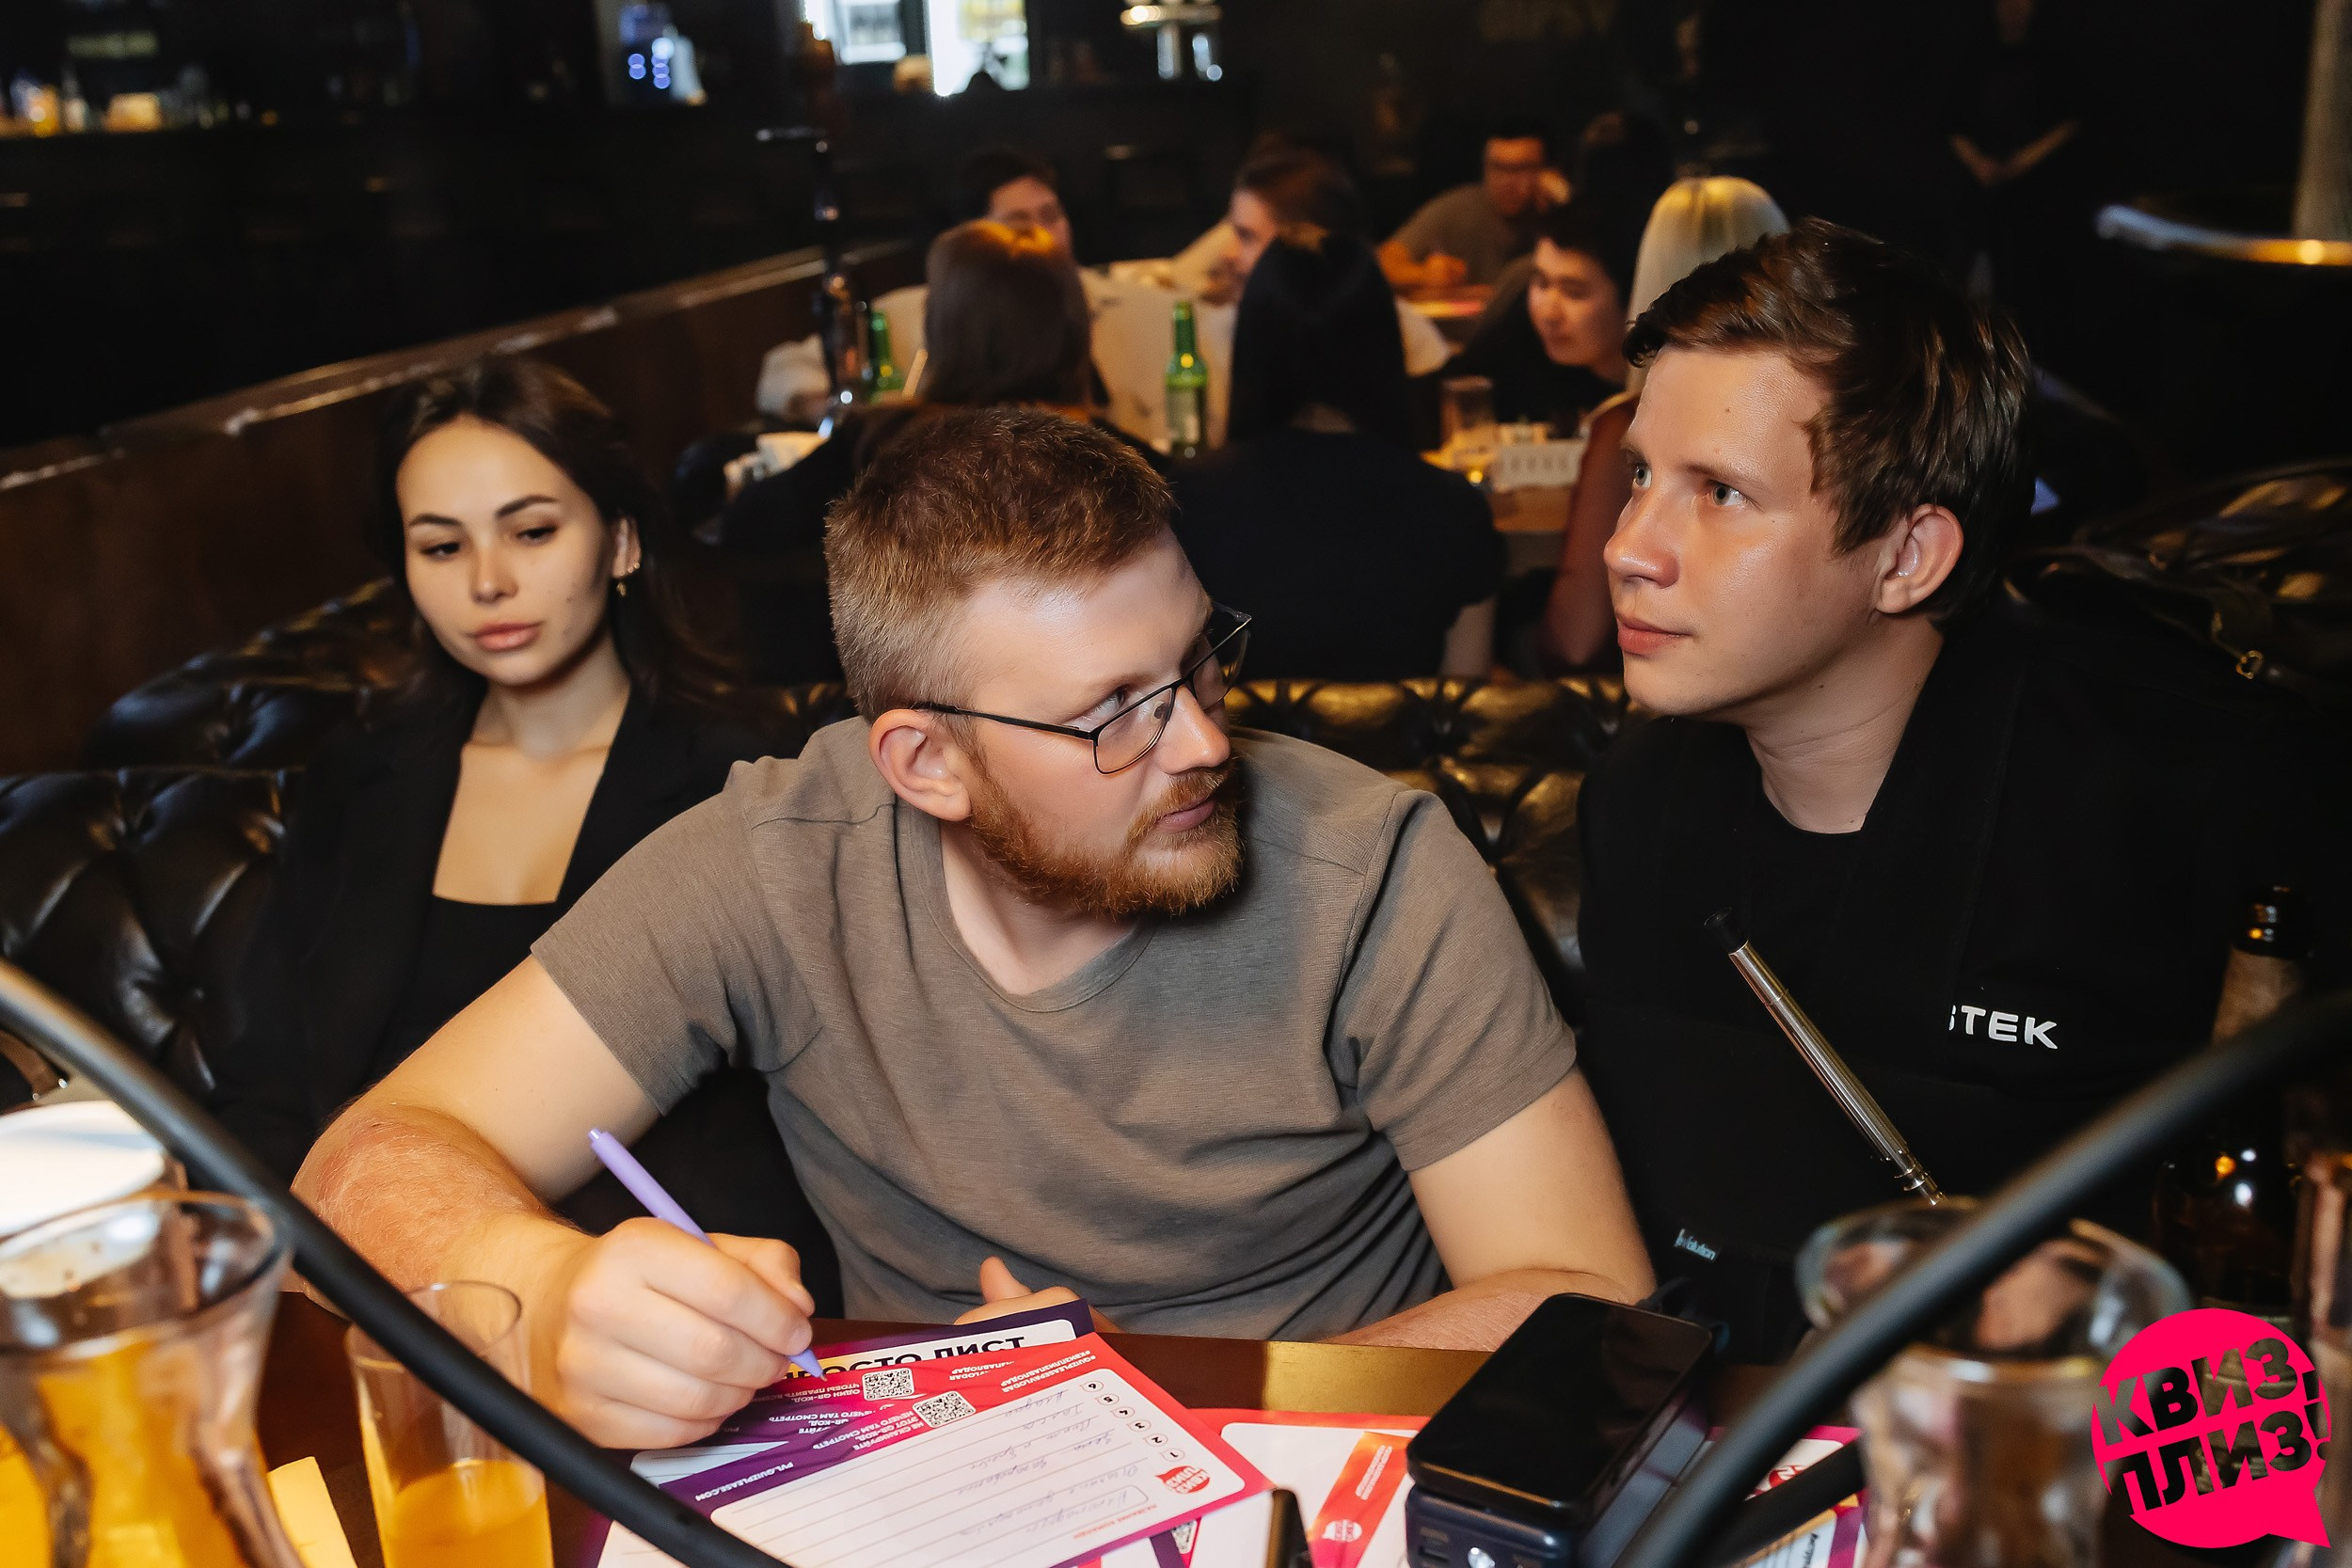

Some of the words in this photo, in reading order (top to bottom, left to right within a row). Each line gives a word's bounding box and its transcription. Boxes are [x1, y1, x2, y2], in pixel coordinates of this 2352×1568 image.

[1002, 1354, 1097, 1393] #QUIZPLEASEPAVLODAR
[827, 1383, 860, 1394] ЧТОБЫ
[834, 1389, 860, 1398] ОДИН
[769, 1413, 818, 1422] СМОТРЕТЬ
[880, 1411, 914, 1426] НЕЧЕГО
[896, 1417, 919, 1429] ЭТОТ
[861, 1420, 882, 1433] ТАМ
[911, 1421, 925, 1432] НЕ
[813, 1429, 861, 1449] СМОТРЕТЬ
[852, 1427, 911, 1451] СКАНИРУЙТЕ
